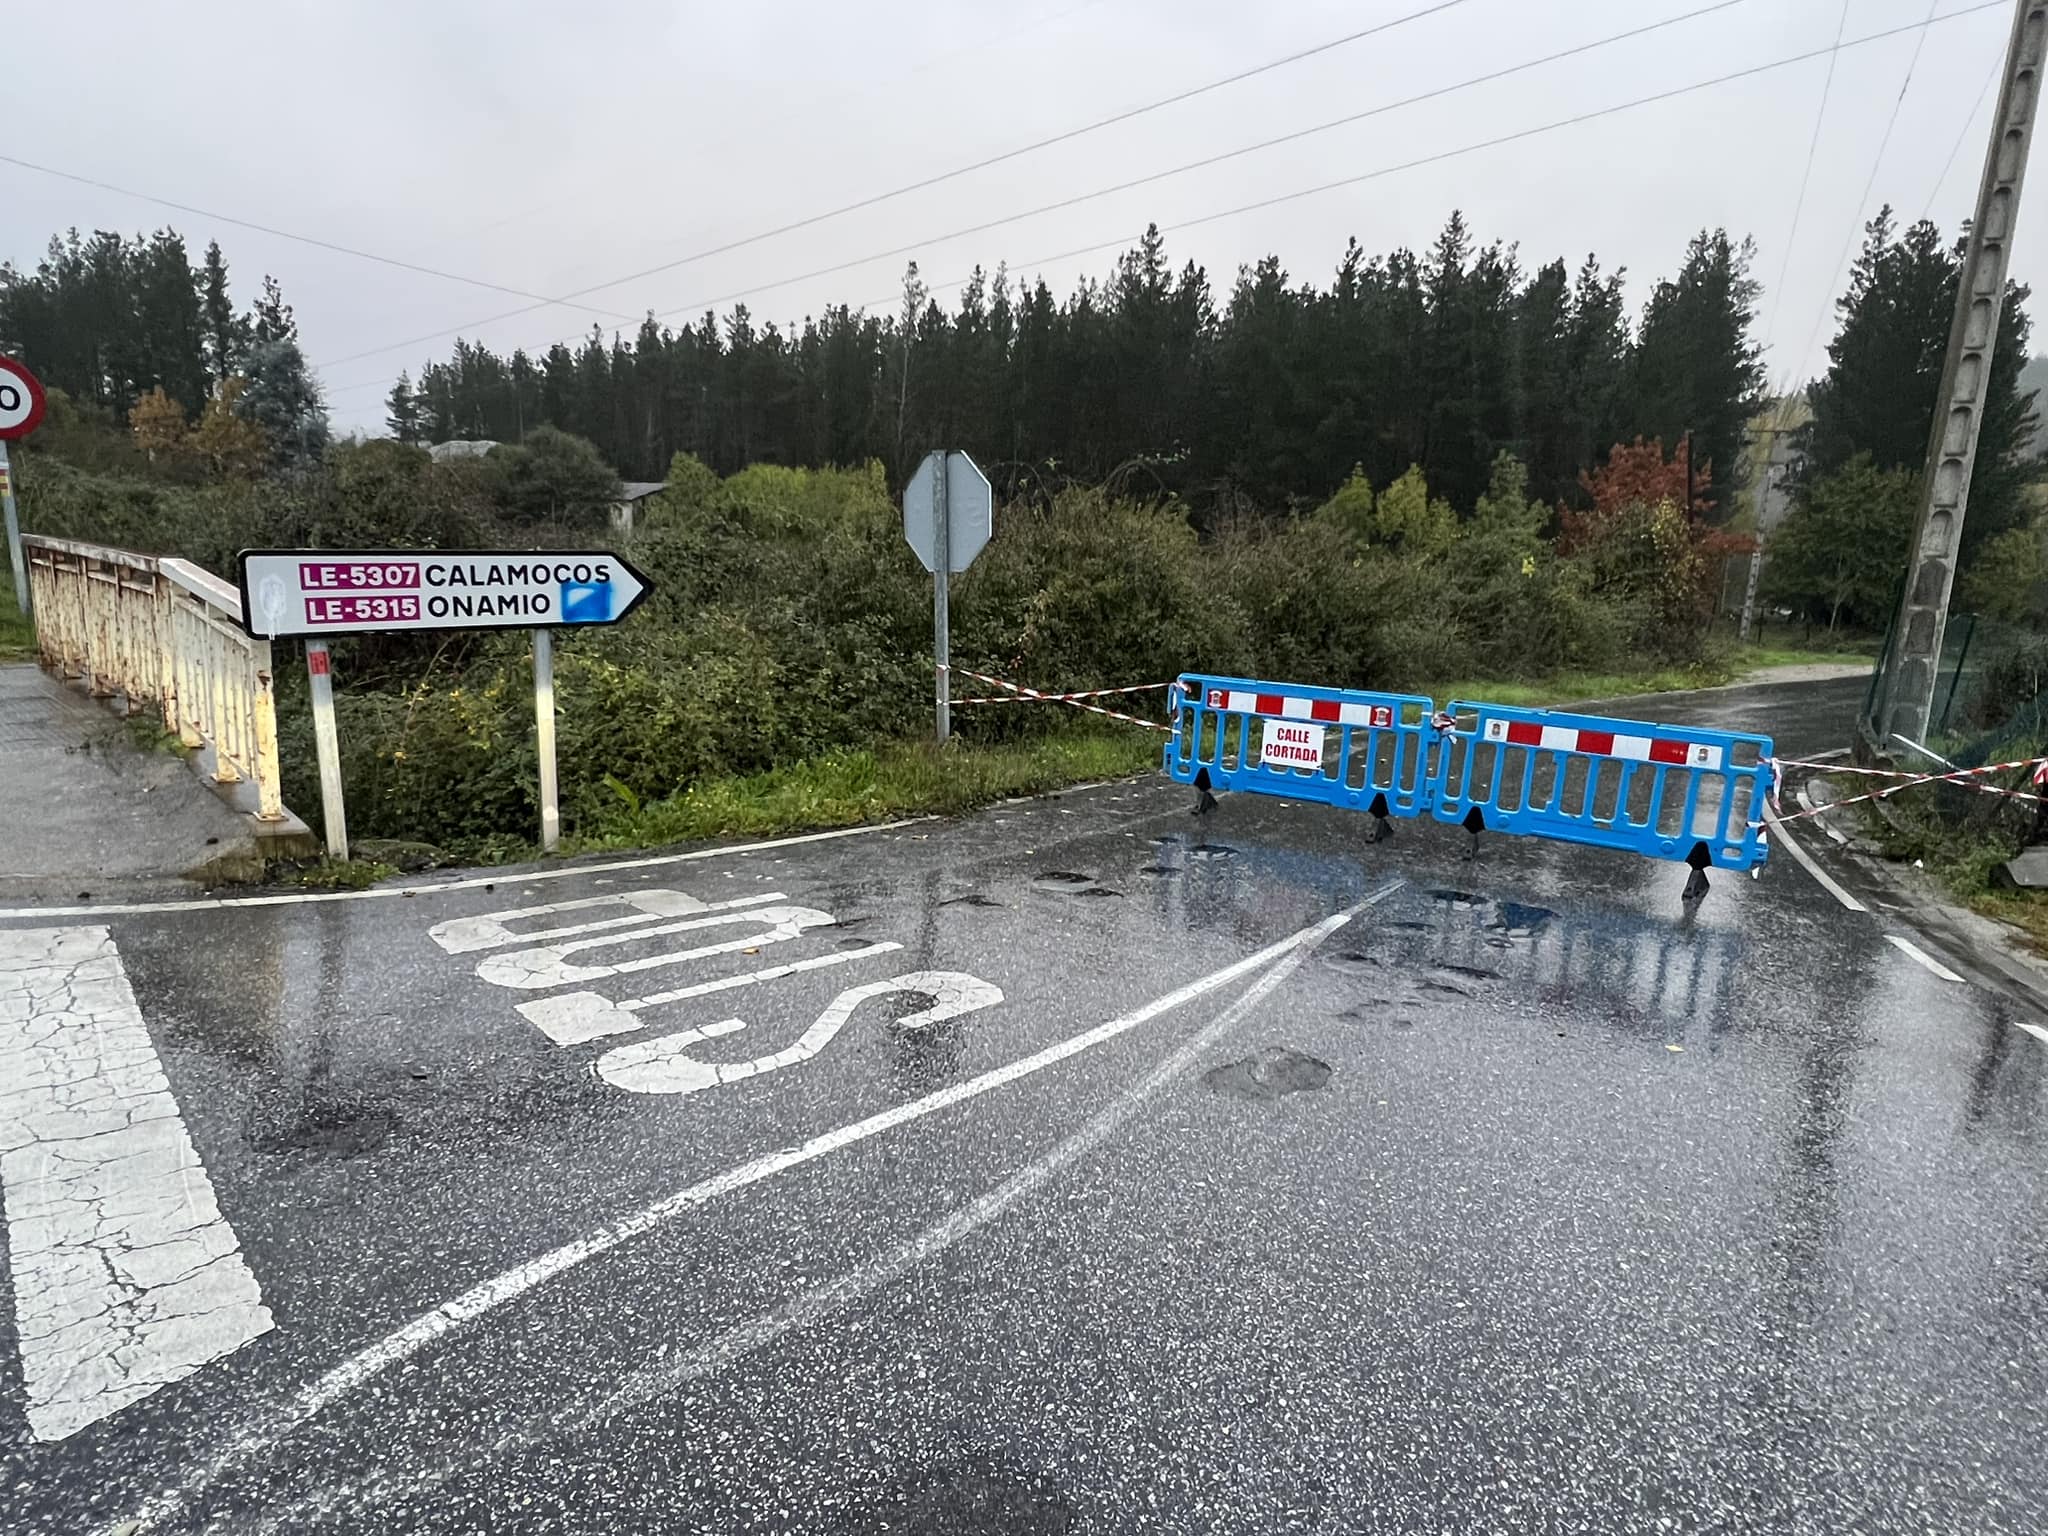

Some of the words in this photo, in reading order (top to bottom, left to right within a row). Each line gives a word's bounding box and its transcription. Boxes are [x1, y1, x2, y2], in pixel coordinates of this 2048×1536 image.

[303, 565, 417, 588] LE-5307
[425, 564, 611, 587] CALAMOCOS
[308, 598, 417, 619] LE-5315
[427, 593, 551, 617] ONAMIO
[1277, 727, 1310, 744] CALLE
[1265, 743, 1318, 762] CORTADA
[427, 889, 1005, 1095] STOP
